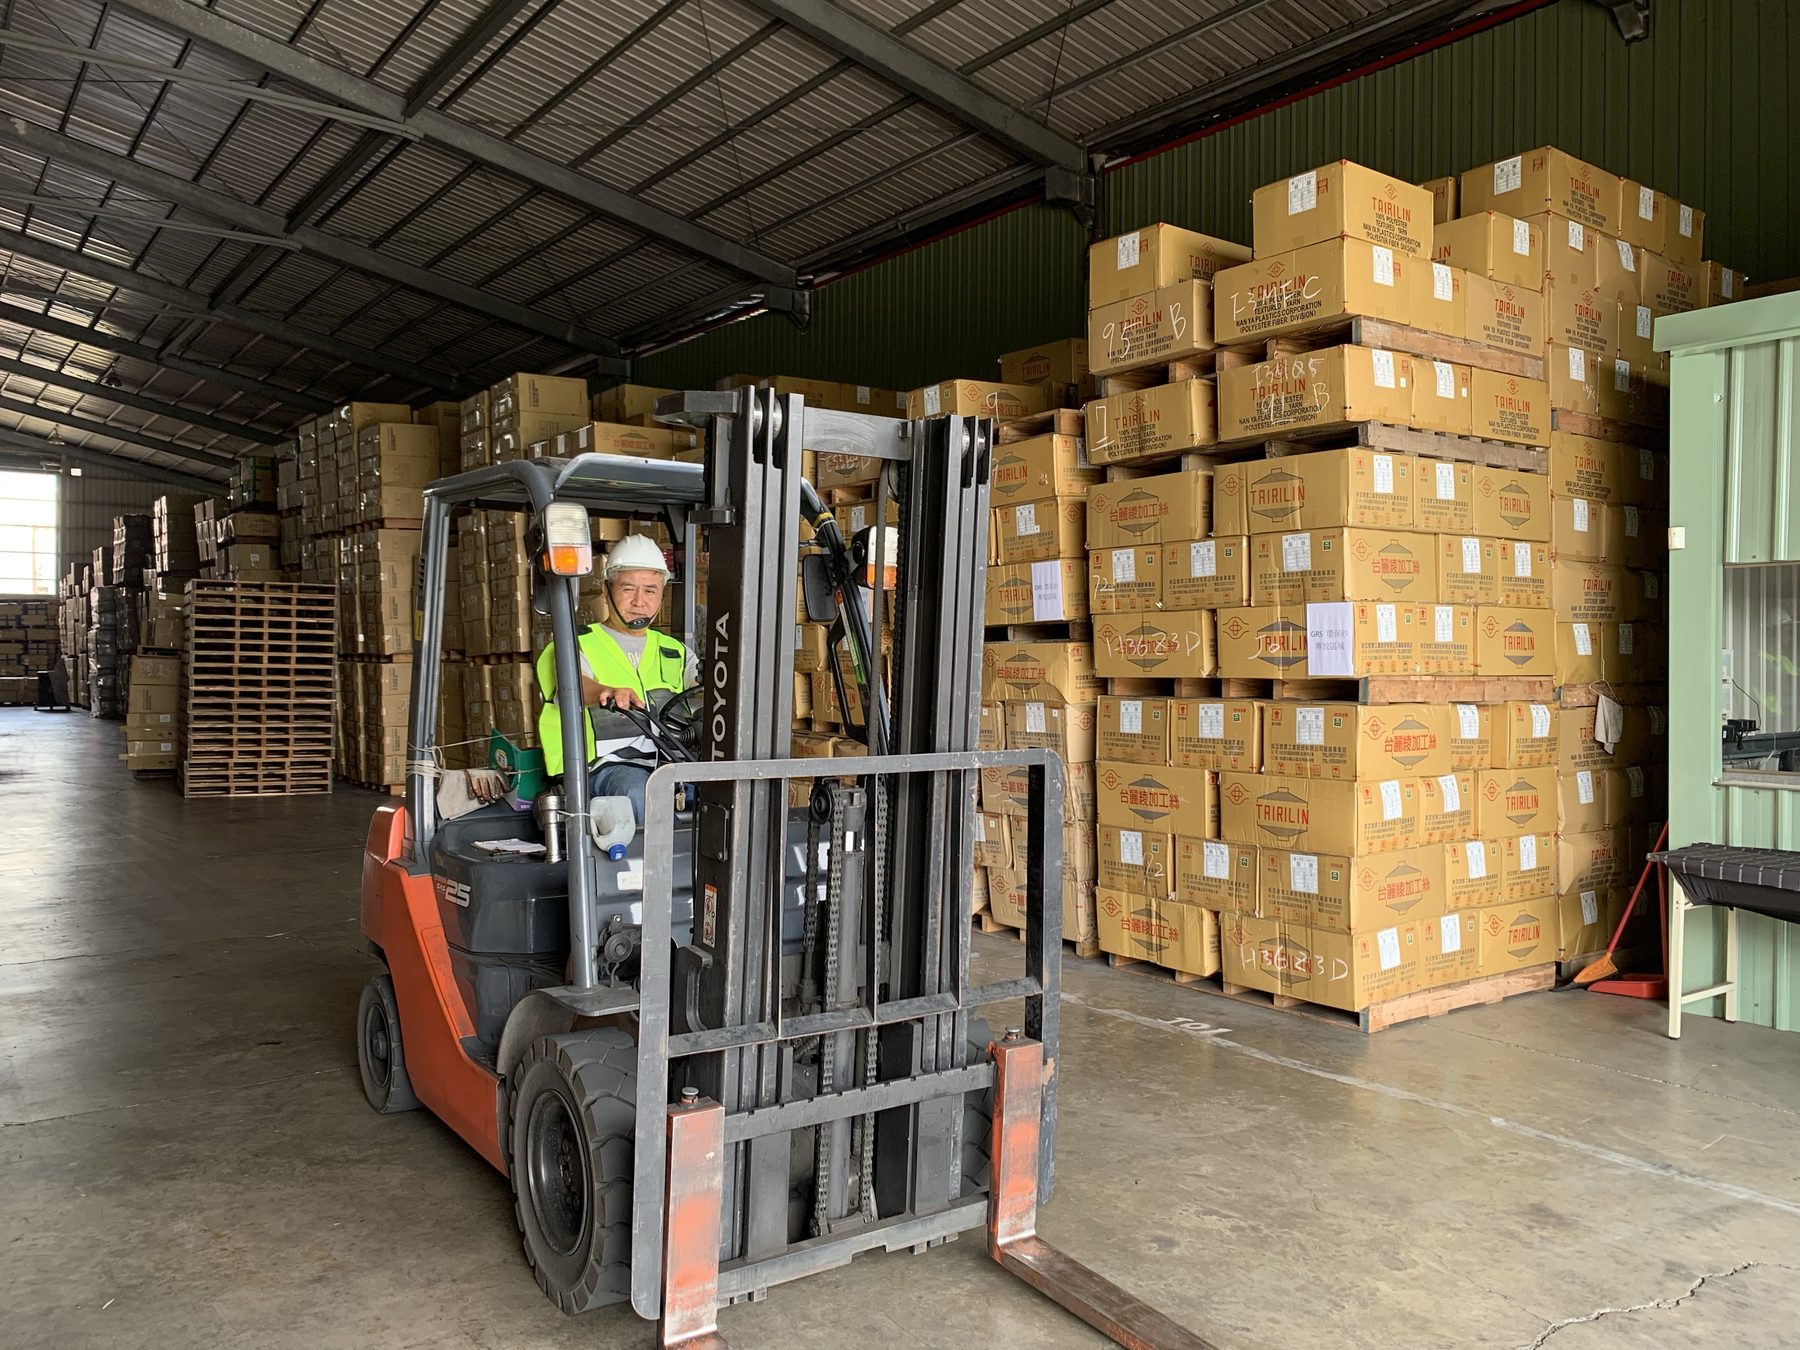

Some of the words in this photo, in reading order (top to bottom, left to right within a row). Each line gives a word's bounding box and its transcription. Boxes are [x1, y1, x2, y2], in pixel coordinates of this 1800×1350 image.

[1372, 197, 1410, 222] TAIRILIN
[1255, 311, 1281, 323] PLASTICS
[1282, 301, 1322, 318] CORPORATION
[1286, 299, 1301, 307] YARN
[1495, 299, 1525, 318] TAIRILIN
[1170, 303, 1186, 340] B
[1272, 318, 1288, 326] FIBER
[1574, 304, 1602, 322] TAIRILIN
[1250, 379, 1306, 401] TAIRILIN
[1312, 383, 1330, 413] B
[1494, 395, 1530, 413] TAIRILIN
[1114, 409, 1160, 429] TAIRILIN
[1574, 456, 1605, 473] TAIRILIN
[1250, 485, 1304, 505] TAIRILIN
[1500, 496, 1531, 515] TAIRILIN
[1504, 634, 1535, 651] TAIRILIN
[712, 612, 730, 761] TOYOTA
[1506, 793, 1538, 811] TAIRILIN
[1256, 803, 1309, 824] TAIRILIN
[445, 879, 471, 908] 25
[1508, 925, 1540, 944] TAIRILIN
